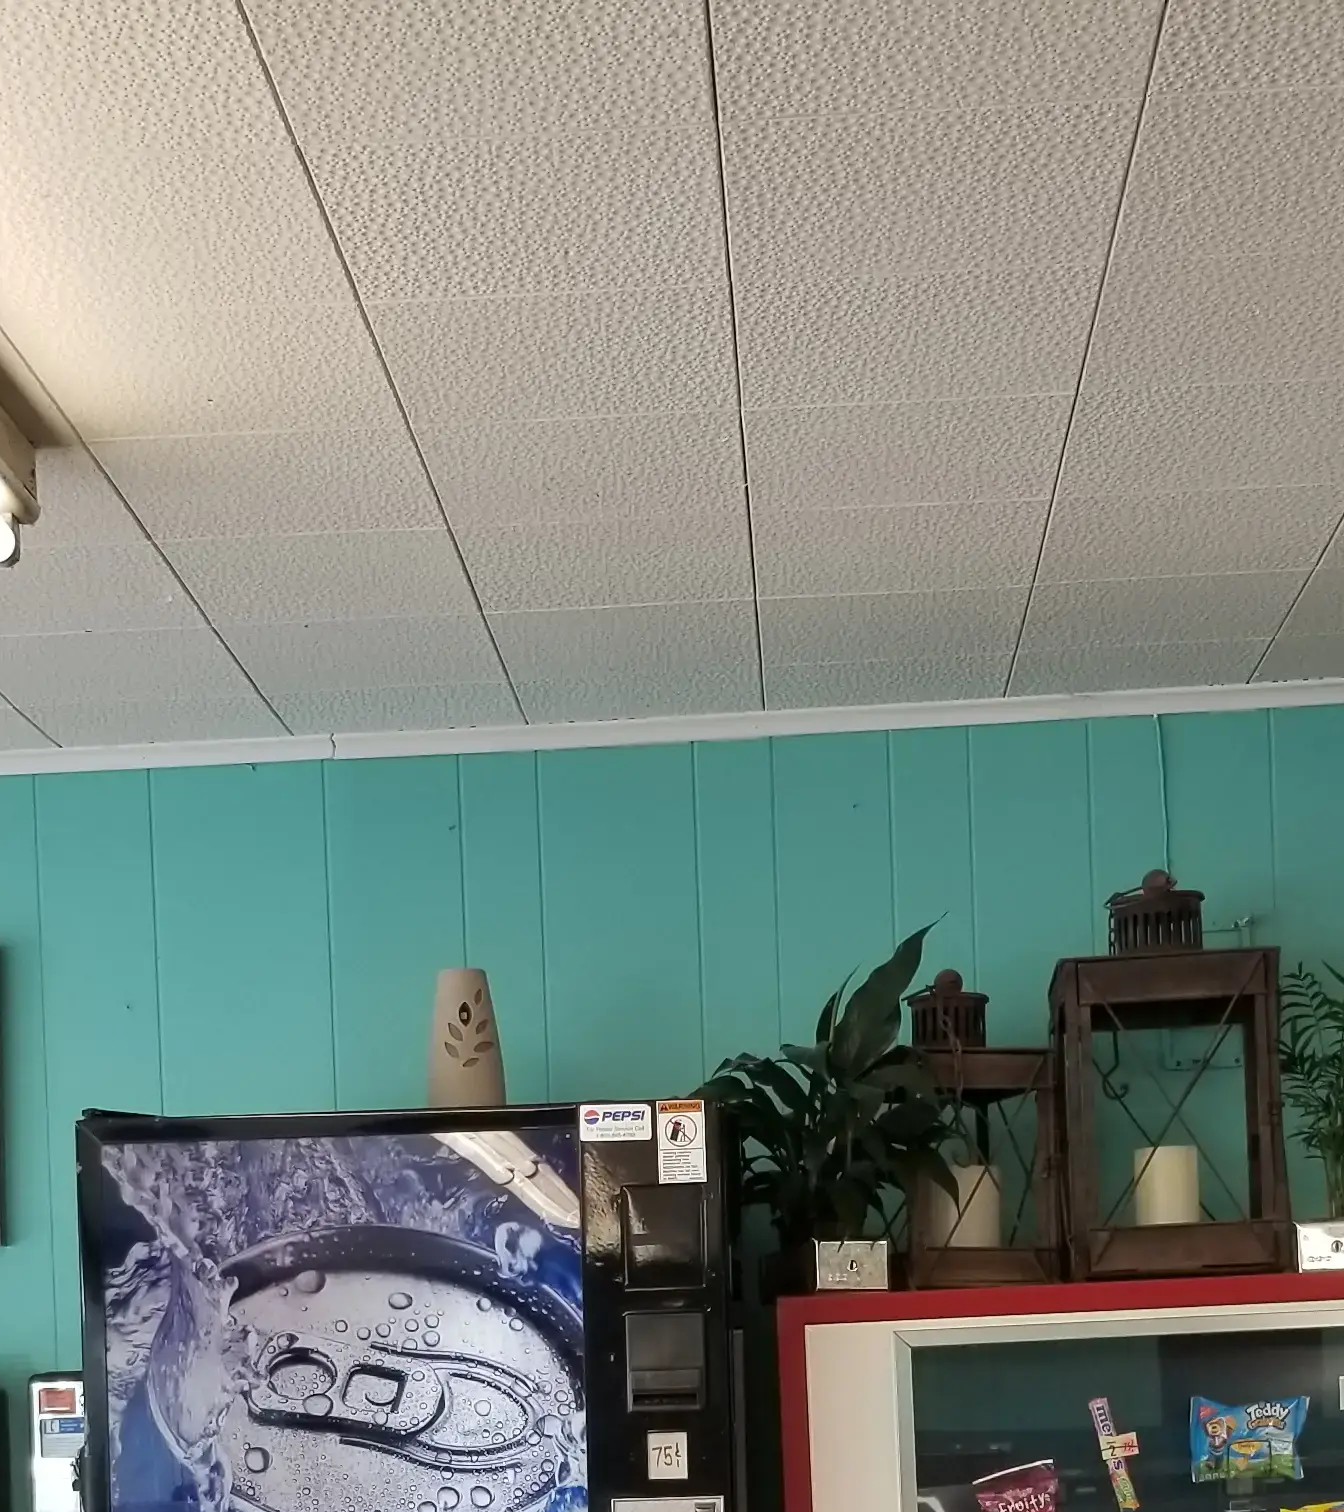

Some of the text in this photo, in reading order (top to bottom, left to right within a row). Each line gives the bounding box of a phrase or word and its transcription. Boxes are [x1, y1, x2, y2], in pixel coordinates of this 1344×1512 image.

[668, 1102, 700, 1110] WARNING
[602, 1110, 645, 1122] PEPSI
[1246, 1403, 1290, 1420] Teddy
